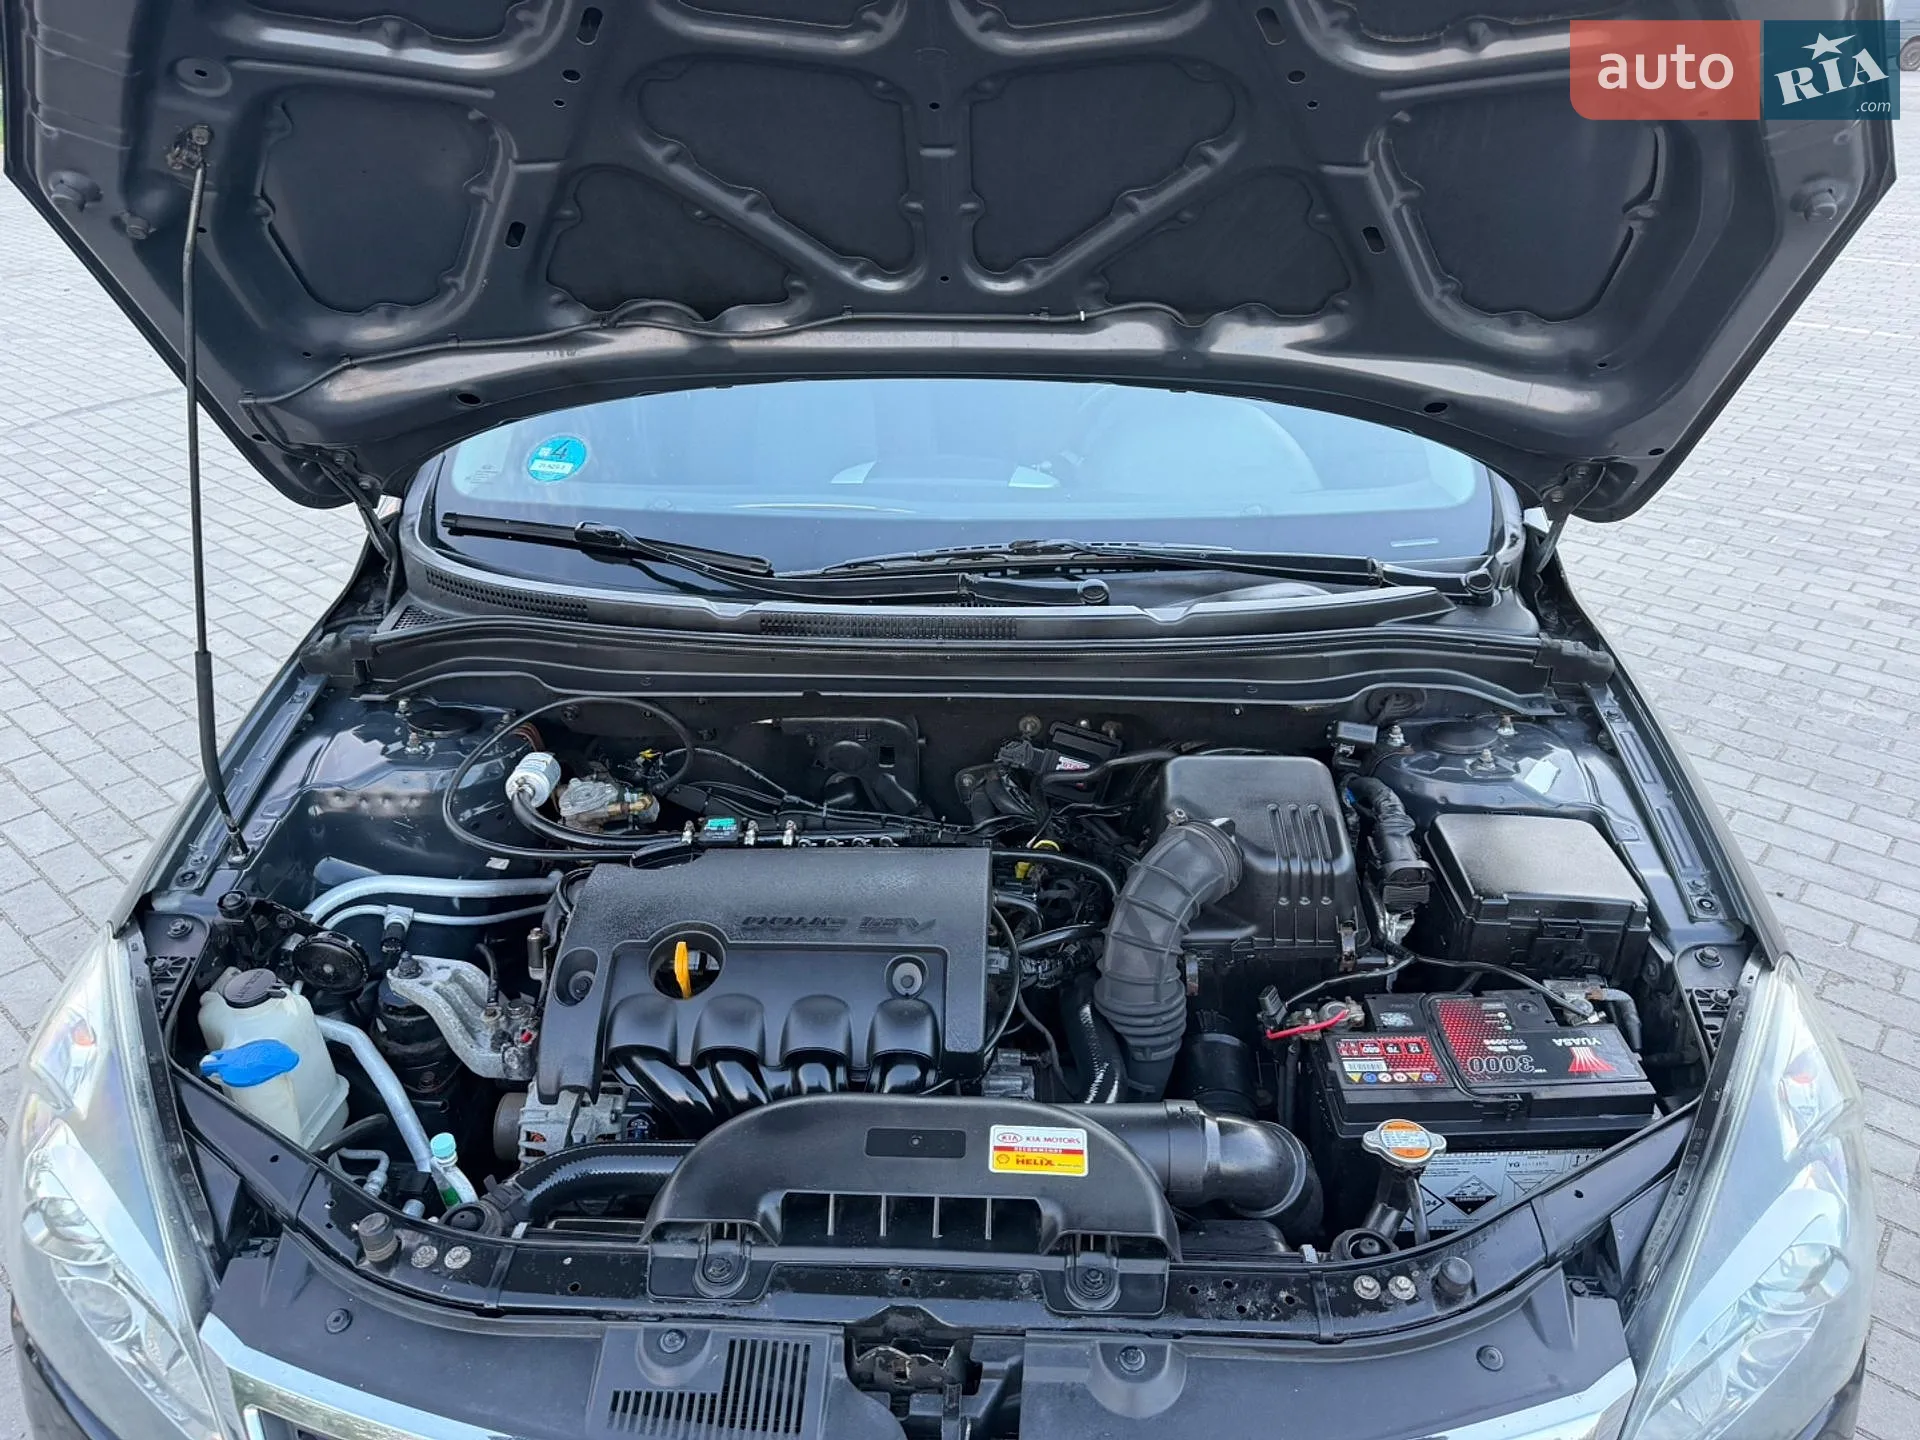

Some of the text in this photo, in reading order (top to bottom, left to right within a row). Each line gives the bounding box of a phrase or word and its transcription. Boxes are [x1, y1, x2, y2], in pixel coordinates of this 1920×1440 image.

[550, 439, 570, 459] 4
[1552, 1037, 1602, 1047] YUASA
[1468, 1055, 1535, 1074] 3000
[1016, 1157, 1055, 1166] HELIX
